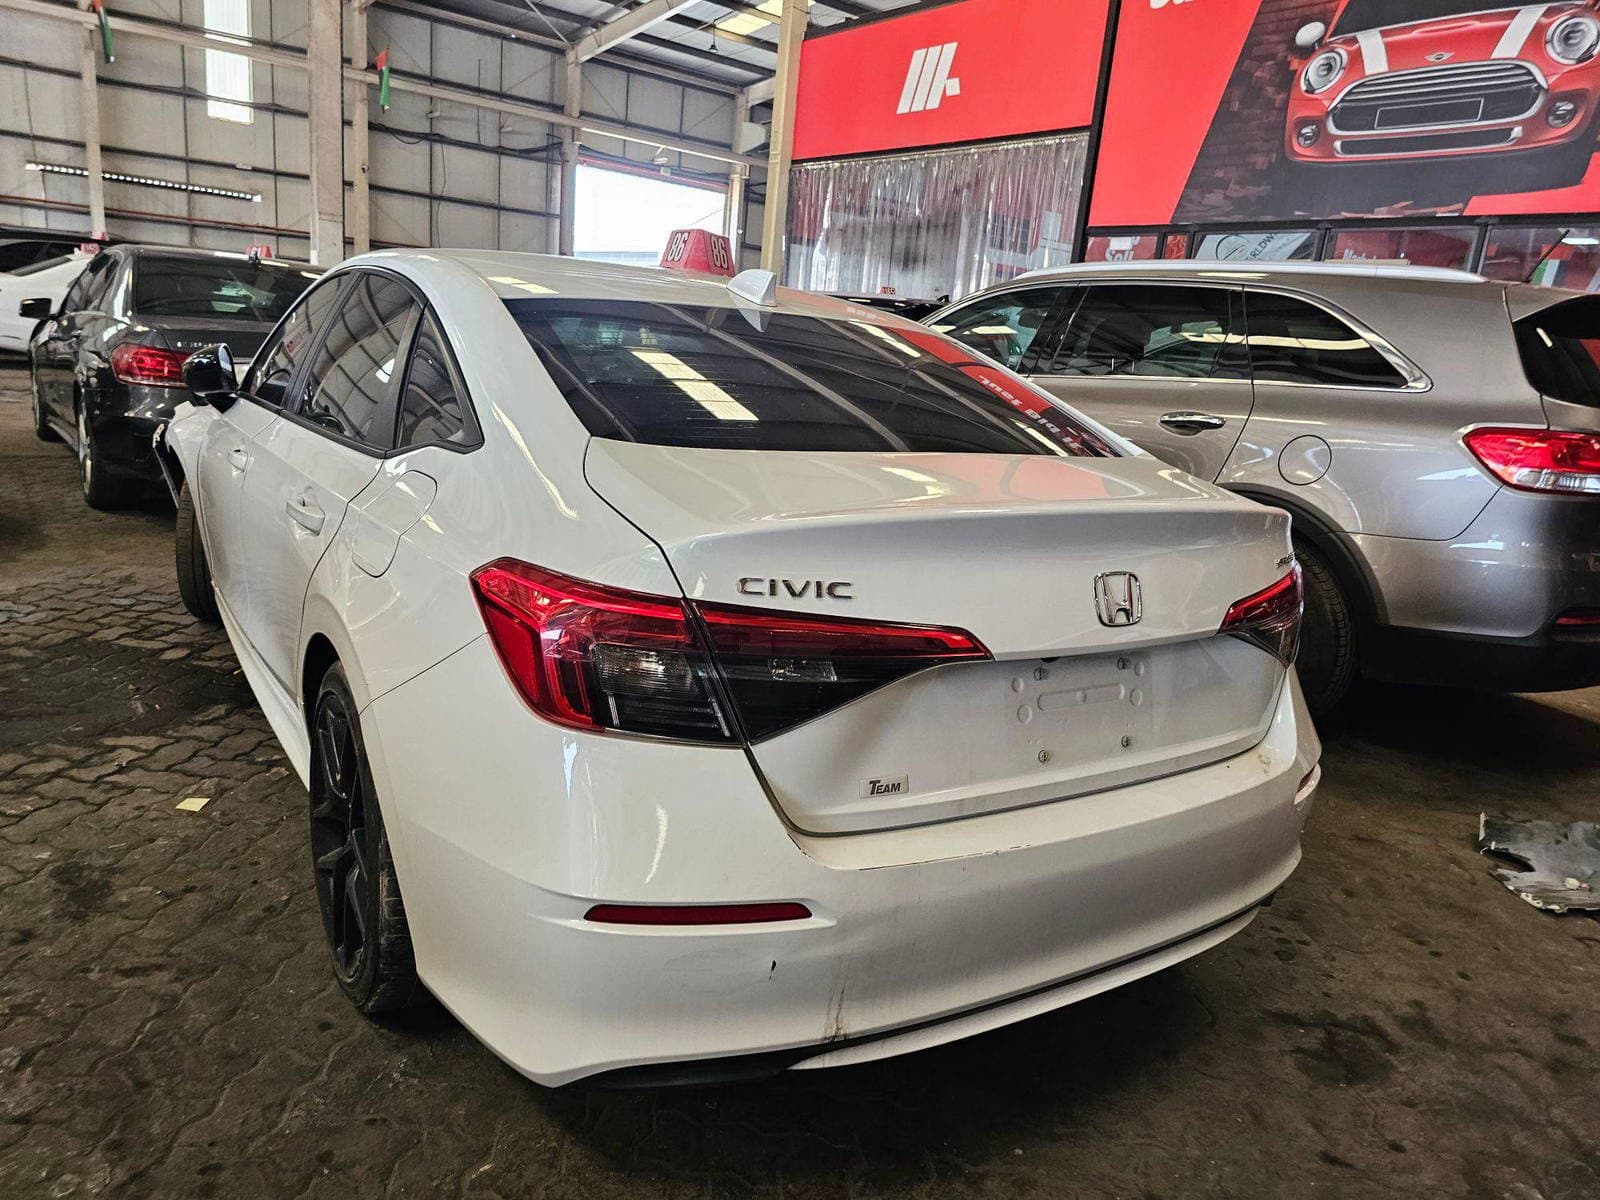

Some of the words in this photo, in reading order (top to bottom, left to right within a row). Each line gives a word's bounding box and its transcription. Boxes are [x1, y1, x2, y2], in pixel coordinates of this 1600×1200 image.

[667, 232, 689, 262] 86
[710, 236, 729, 269] 86
[737, 577, 853, 600] CIVIC
